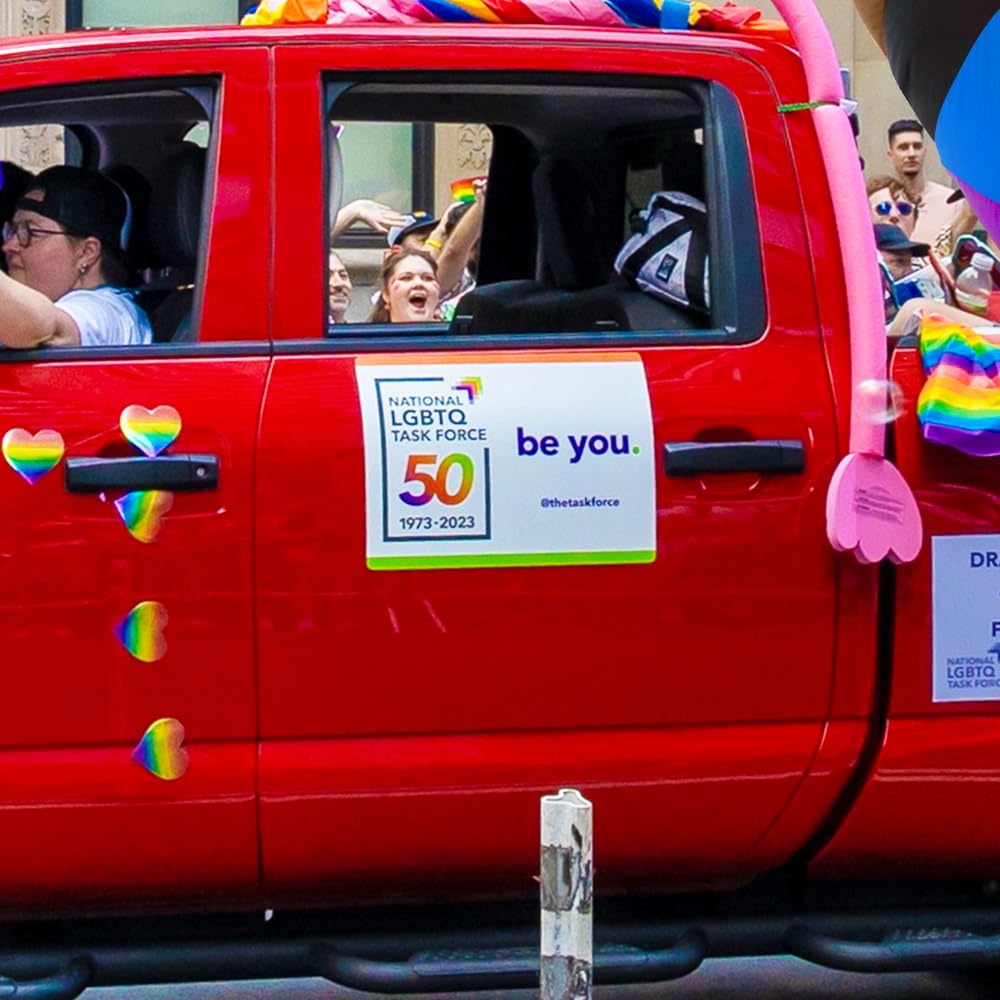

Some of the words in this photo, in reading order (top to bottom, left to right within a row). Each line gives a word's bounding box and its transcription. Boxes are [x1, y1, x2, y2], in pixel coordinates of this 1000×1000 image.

[388, 395, 464, 407] NATIONAL
[390, 408, 468, 427] LGBTQ
[391, 429, 431, 442] TASK
[435, 428, 487, 441] FORCE
[516, 426, 560, 456] be
[568, 434, 641, 464] you.
[398, 452, 475, 507] 50
[540, 496, 620, 508] @thetaskforce
[399, 516, 476, 530] 1973-2023
[947, 657, 995, 665] NATIONAL
[947, 666, 996, 679] LGBTQ
[947, 679, 973, 688] TASK
